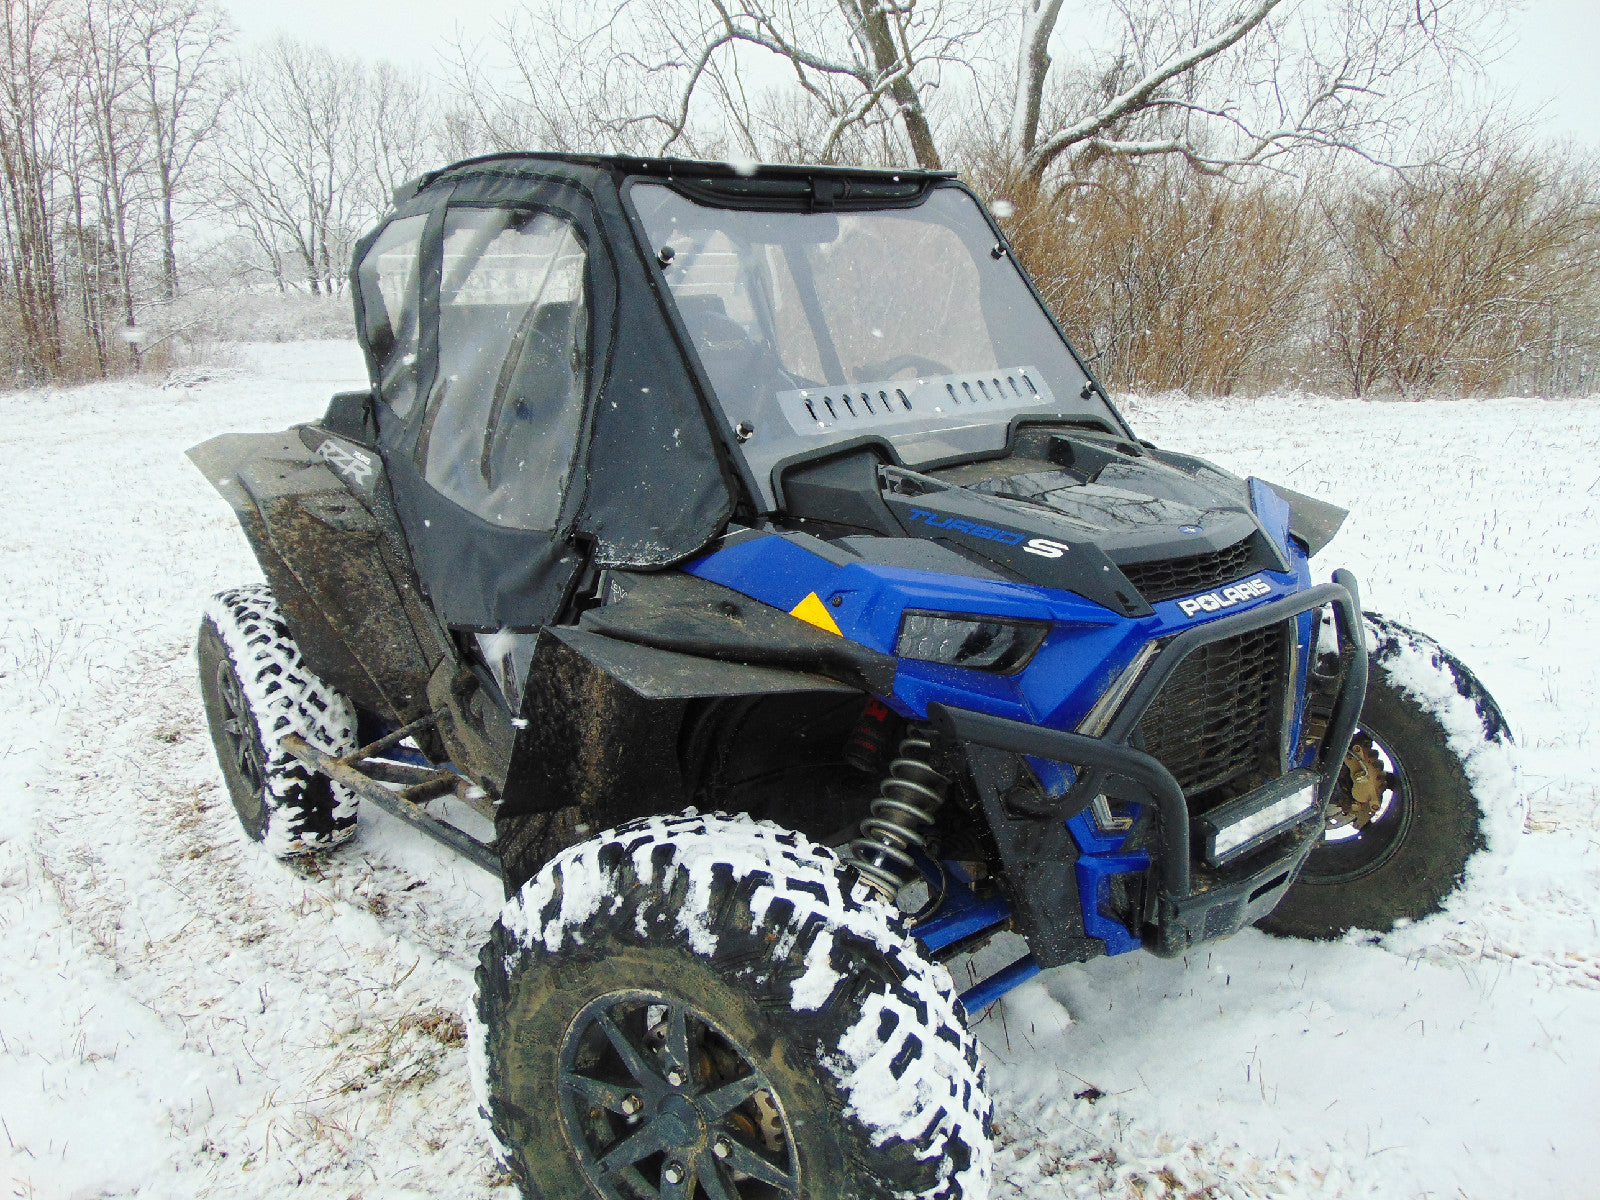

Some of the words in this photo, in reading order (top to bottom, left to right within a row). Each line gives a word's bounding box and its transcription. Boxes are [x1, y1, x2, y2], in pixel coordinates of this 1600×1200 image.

[315, 439, 373, 486] RZR
[908, 508, 1026, 546] TURBO
[1022, 538, 1070, 559] S
[1176, 578, 1271, 618] POLARIS
